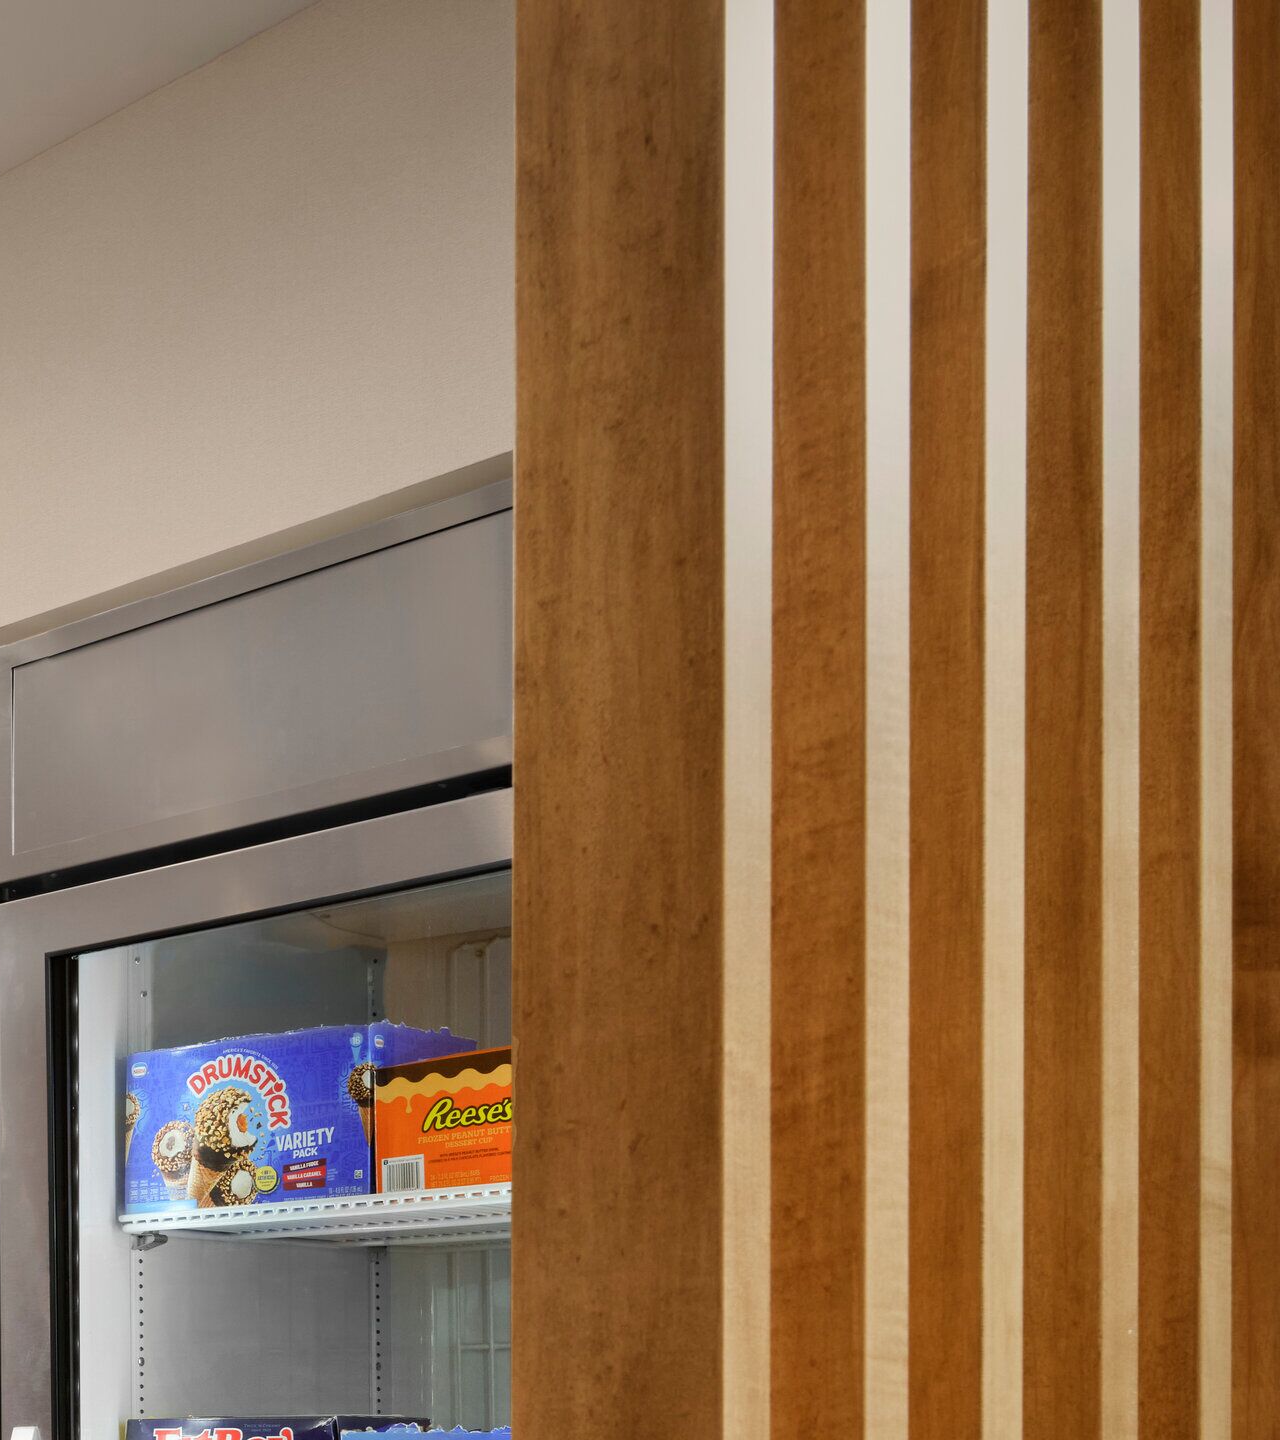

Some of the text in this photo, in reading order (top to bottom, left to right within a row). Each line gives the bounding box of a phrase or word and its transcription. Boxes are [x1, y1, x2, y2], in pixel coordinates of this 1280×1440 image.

[186, 1053, 292, 1131] DRUMSTICK
[276, 1126, 335, 1153] VARIETY
[417, 1130, 486, 1145] FROZEN PEANUT
[293, 1146, 318, 1160] PACK
